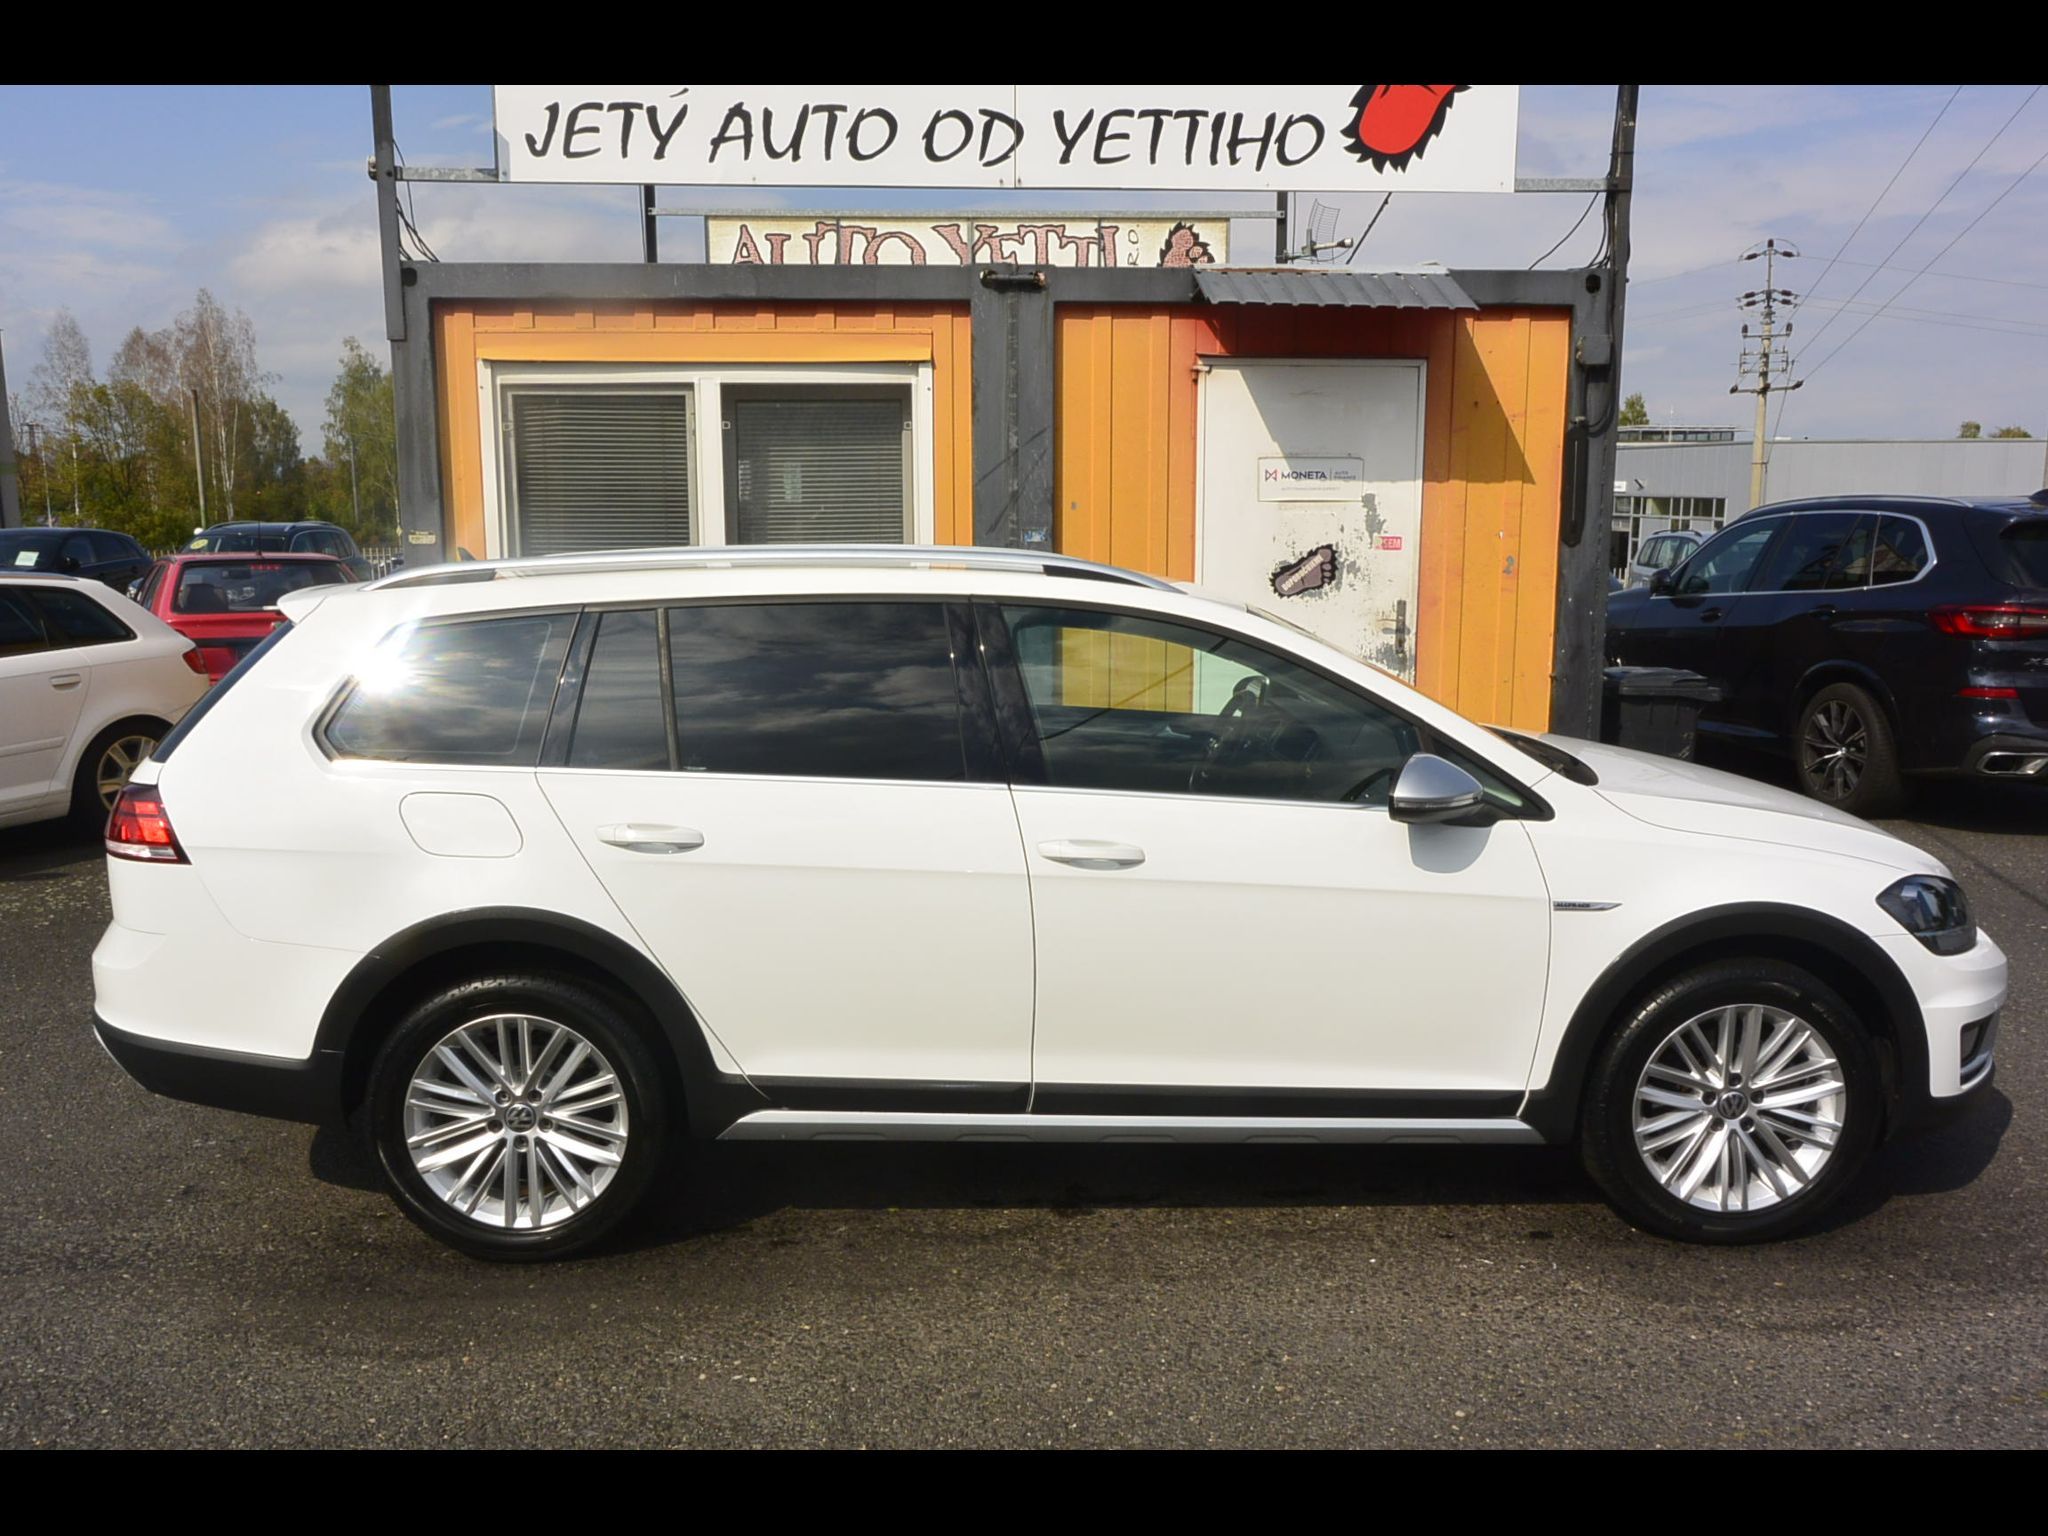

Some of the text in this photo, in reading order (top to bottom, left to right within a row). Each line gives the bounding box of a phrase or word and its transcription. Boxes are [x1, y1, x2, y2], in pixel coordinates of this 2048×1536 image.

[525, 87, 1326, 172] JETÝ AUTO OD YETTIHO
[1281, 471, 1327, 480] MONETA
